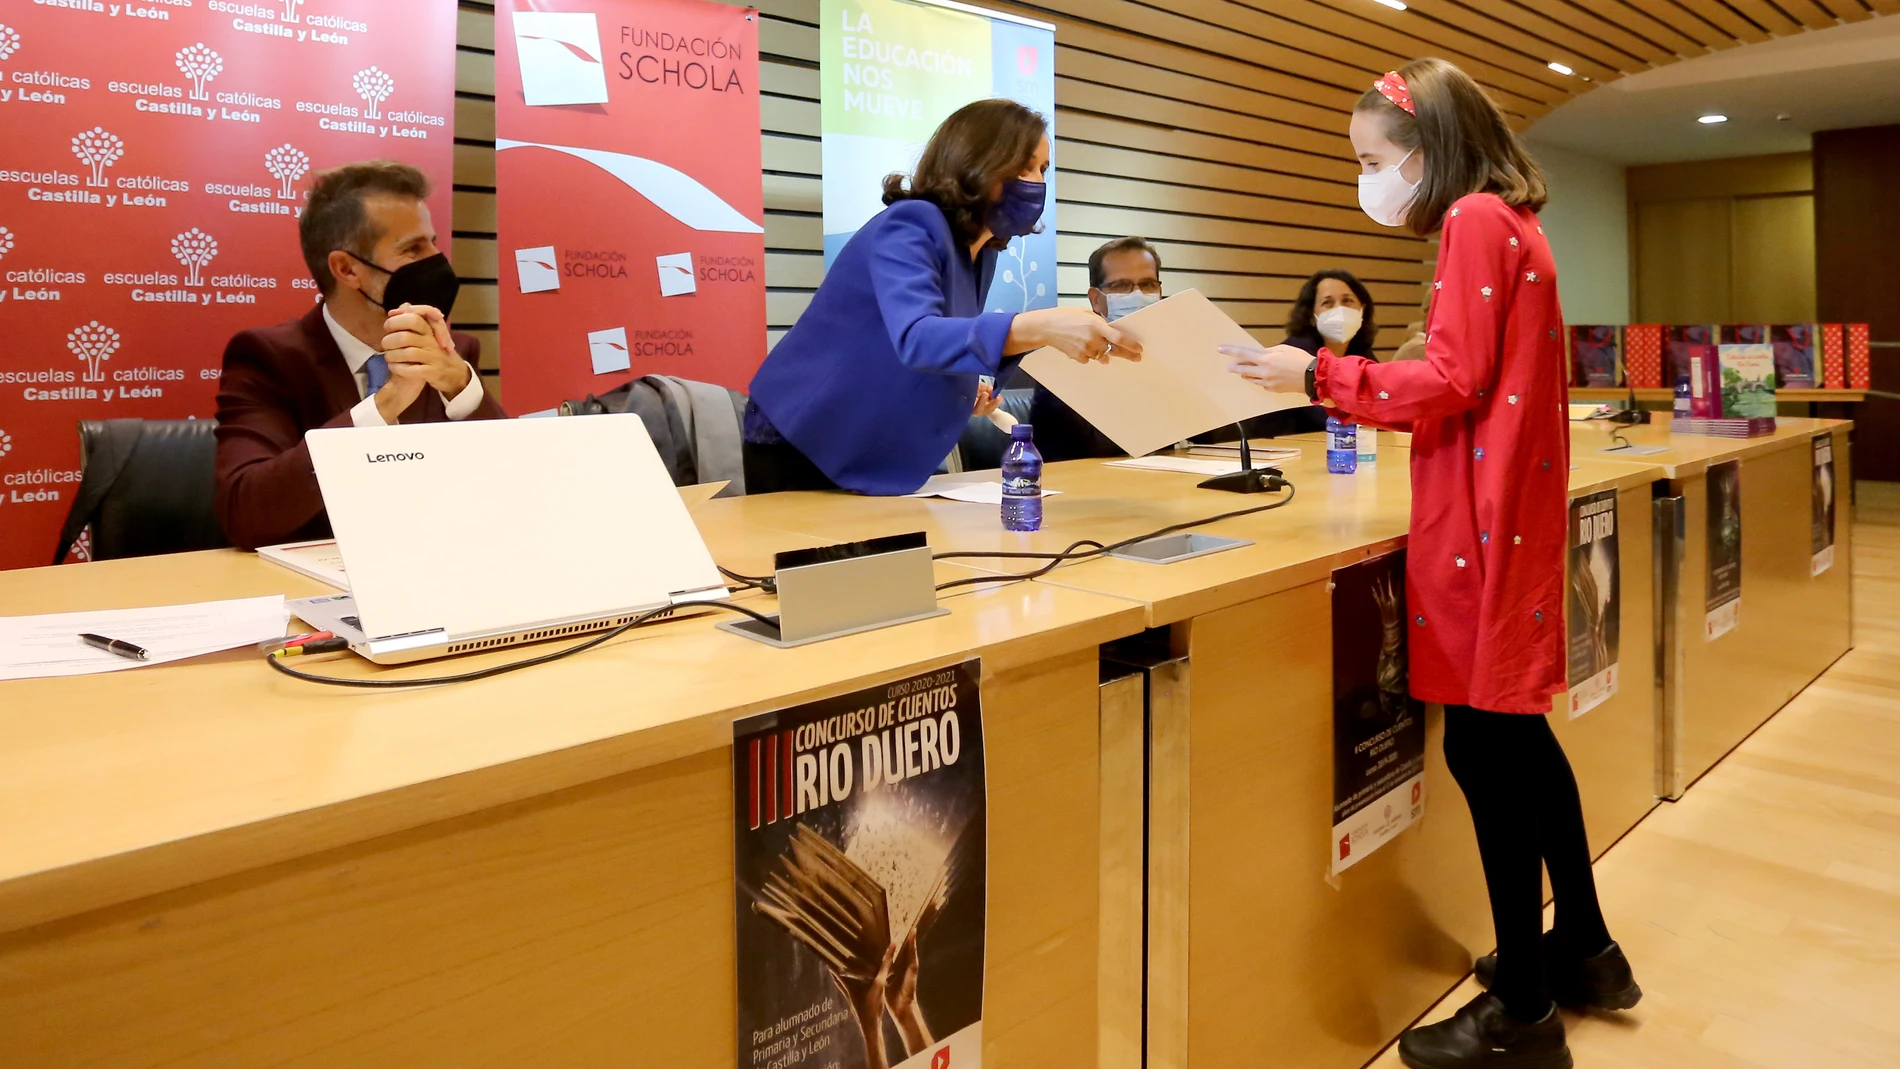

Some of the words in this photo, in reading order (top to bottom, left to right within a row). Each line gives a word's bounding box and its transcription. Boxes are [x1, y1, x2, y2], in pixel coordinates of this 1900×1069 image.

[109, 4, 120, 17] y
[125, 4, 170, 20] León
[208, 0, 275, 20] escuelas
[306, 14, 368, 33] católicas
[841, 9, 873, 35] LA
[232, 18, 294, 38] Castilla
[297, 30, 307, 42] y
[311, 29, 348, 45] León
[620, 25, 742, 61] FUNDACIÓN
[842, 36, 972, 77] EDUCACIÓN
[12, 71, 91, 90] católicas
[619, 51, 744, 95] SCHOLA
[842, 62, 894, 90] NOS
[0, 88, 12, 103] y
[18, 87, 66, 104] León
[108, 80, 183, 98] escuelas
[216, 91, 281, 110] católicas
[843, 89, 924, 121] MUEVE
[135, 99, 203, 117] Castilla
[206, 108, 217, 121] y
[221, 106, 261, 123] León
[296, 101, 359, 118] escuelas
[387, 110, 445, 127] católicas
[319, 117, 376, 135] Castilla
[379, 126, 389, 138] y
[392, 125, 427, 139] León
[0, 170, 79, 186] escuelas
[116, 175, 190, 192] católicas
[205, 182, 271, 199] escuelas
[28, 187, 101, 204] Castilla
[106, 194, 117, 208] y
[122, 192, 166, 207] León
[228, 199, 290, 216] Castilla
[564, 249, 627, 263] FUNDACIÓN
[699, 254, 755, 267] FUNDACIÓN
[5, 268, 86, 284] católicas
[103, 271, 178, 286] escuelas
[210, 274, 277, 289] católicas
[563, 262, 628, 279] SCHOLA
[699, 267, 756, 282] SCHOLA
[12, 287, 61, 301] León
[131, 289, 198, 303] Castilla
[201, 293, 212, 306] y
[215, 291, 256, 304] León
[634, 328, 694, 341] FUNDACIÓN
[633, 341, 694, 357] SCHOLA
[113, 366, 185, 382] católicas
[23, 386, 98, 401] Castilla
[102, 389, 114, 402] y
[119, 385, 163, 399] León
[366, 451, 425, 464] Lenovo
[4, 468, 83, 486] católicas
[11, 488, 60, 504] León
[887, 682, 910, 699] CURSO
[912, 670, 955, 692] 2020-2021
[795, 705, 876, 753] CONCURSO
[878, 700, 896, 729] DE
[897, 683, 958, 724] CUENTOS
[796, 742, 853, 815] RIO
[861, 710, 961, 793] DUERO
[752, 1025, 773, 1046] Para
[775, 1003, 820, 1036] alumnado
[822, 996, 834, 1013] de
[752, 1036, 791, 1065] Primaria
[792, 1033, 799, 1049] y
[800, 1008, 849, 1042] Secundaria
[766, 1047, 800, 1069] Castilla
[801, 1048, 808, 1064] y
[809, 1034, 831, 1055] León
